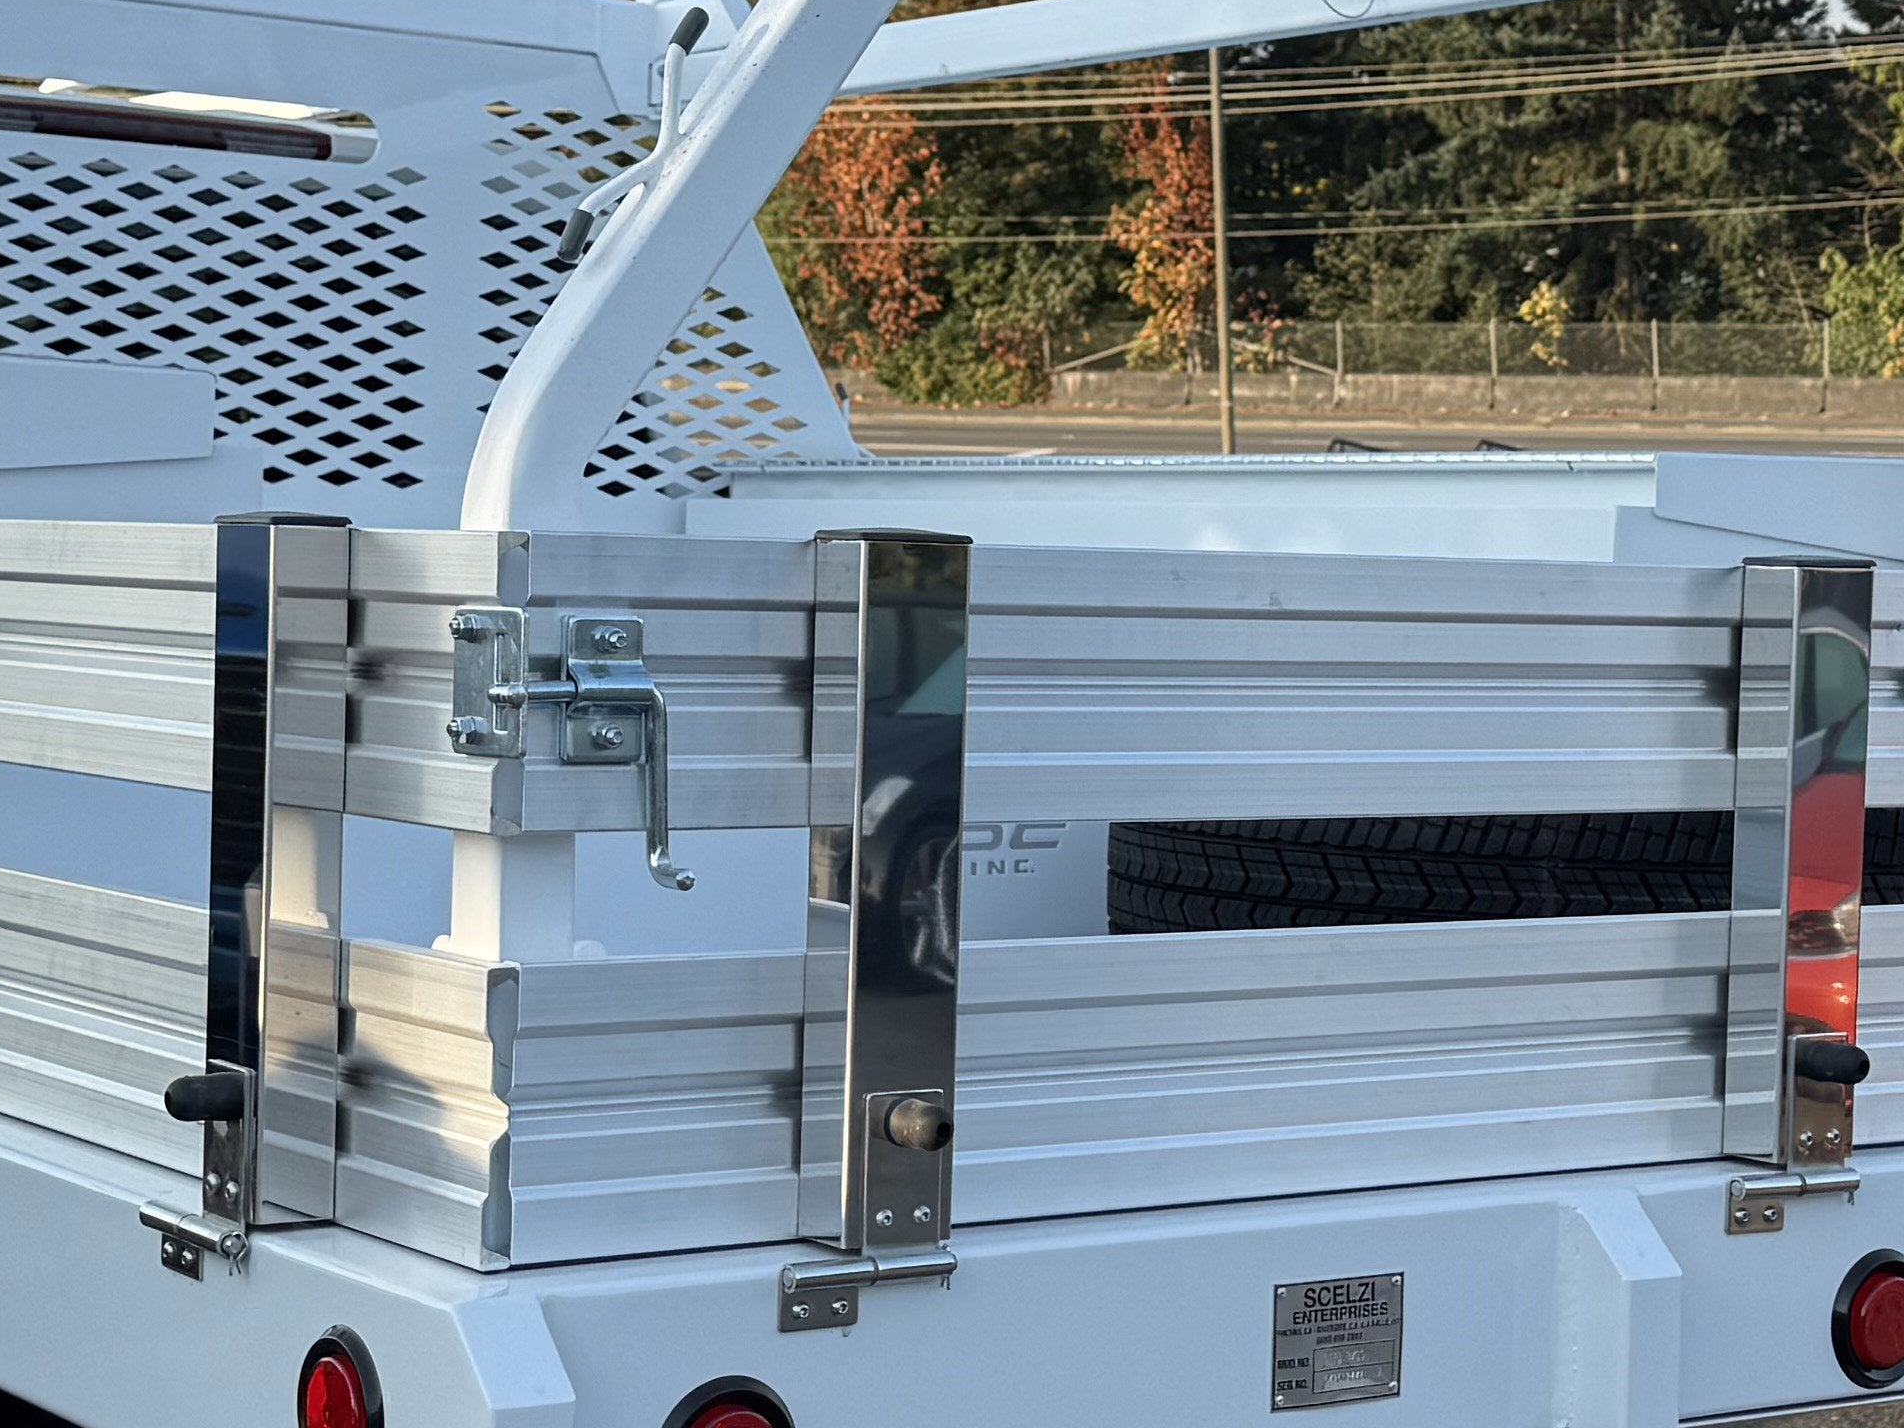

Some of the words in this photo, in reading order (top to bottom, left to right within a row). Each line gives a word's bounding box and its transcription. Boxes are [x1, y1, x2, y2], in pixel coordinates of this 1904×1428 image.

[970, 858, 1036, 876] INC.
[1303, 1280, 1376, 1309] SCELZI
[1292, 1301, 1389, 1326] ENTERPRISES
